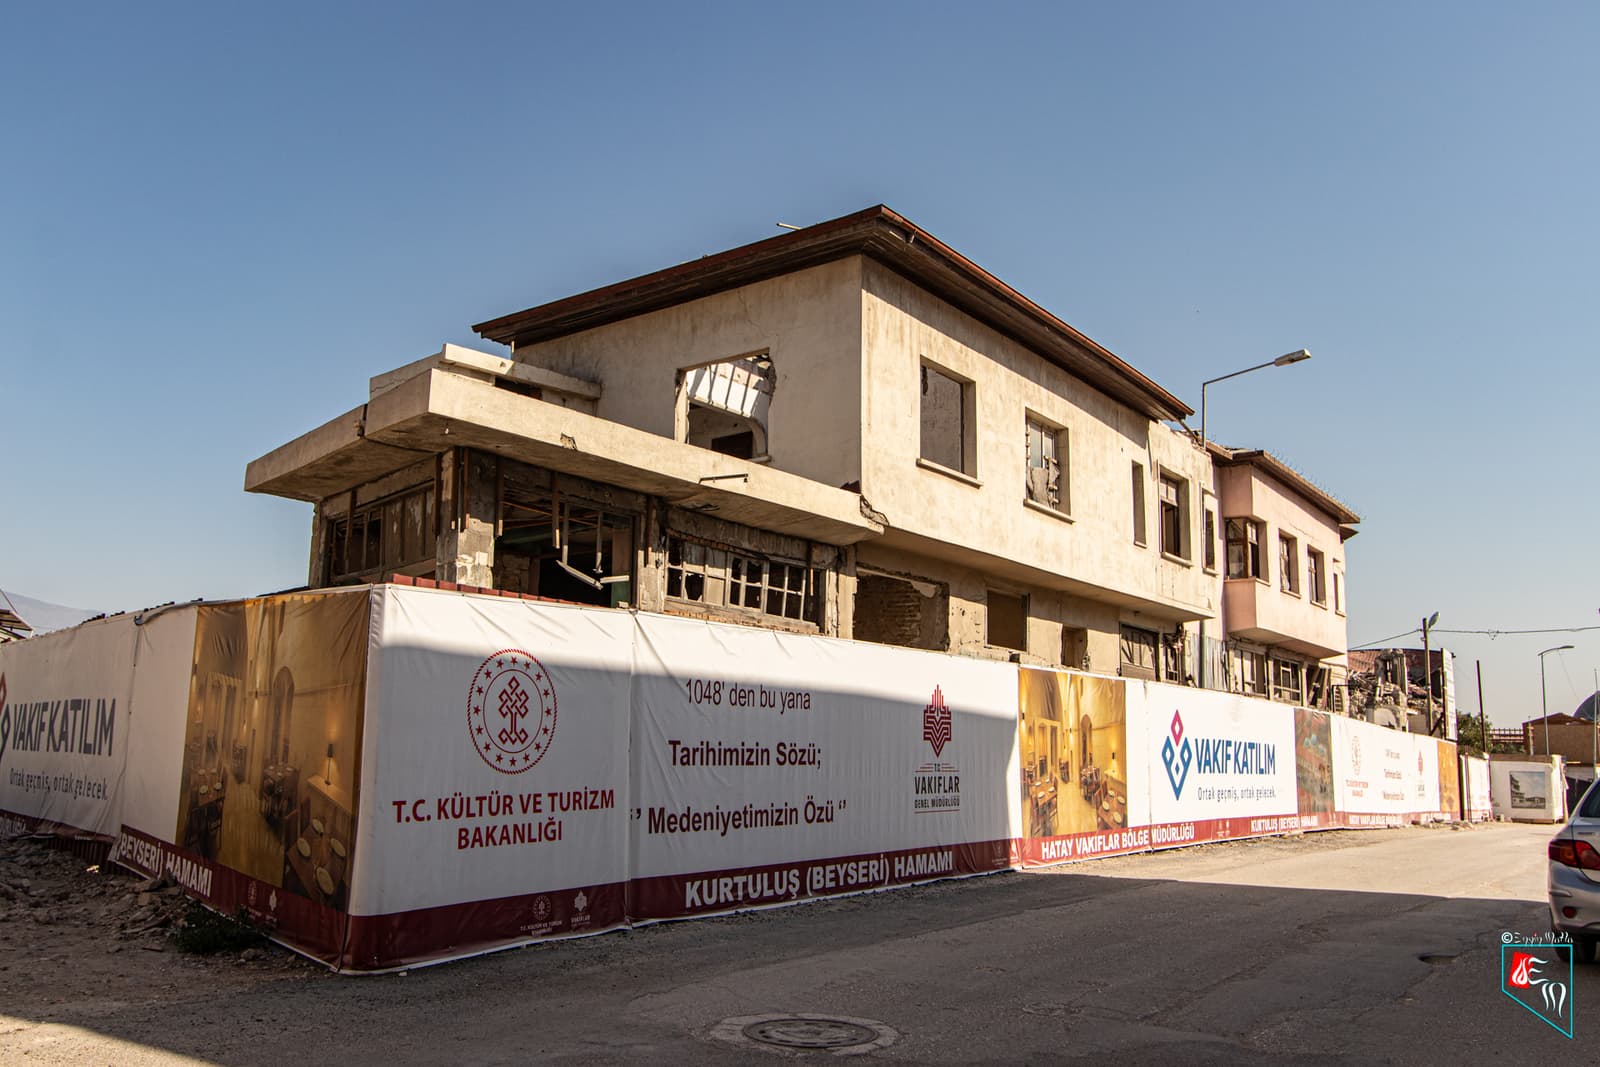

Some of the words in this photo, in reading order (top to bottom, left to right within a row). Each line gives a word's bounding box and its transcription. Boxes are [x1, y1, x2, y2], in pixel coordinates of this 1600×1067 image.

[729, 682, 755, 707] den
[760, 684, 776, 708] bu
[780, 690, 811, 715] yana
[668, 740, 770, 766] Tarihimizin
[776, 742, 821, 769] Sözü;
[914, 775, 960, 795] VAKIFLAR
[392, 799, 431, 823] T.C.
[437, 791, 513, 820] KÜLTÜR
[519, 793, 543, 814] VE
[548, 786, 614, 812] TURİZM
[648, 802, 799, 837] Medeniyetimizin
[804, 795, 834, 824] Özü
[457, 817, 562, 850] BAKANLIĞI
[1041, 838, 1074, 860] HATAY
[1075, 832, 1120, 855] VAKIFLAR
[1121, 826, 1149, 848] BÖLGE
[165, 852, 213, 898] HAMAMI
[685, 867, 800, 909] KURTULUŞ
[806, 853, 890, 896] (BEYSERİ)
[895, 850, 953, 879] HAMAMI
